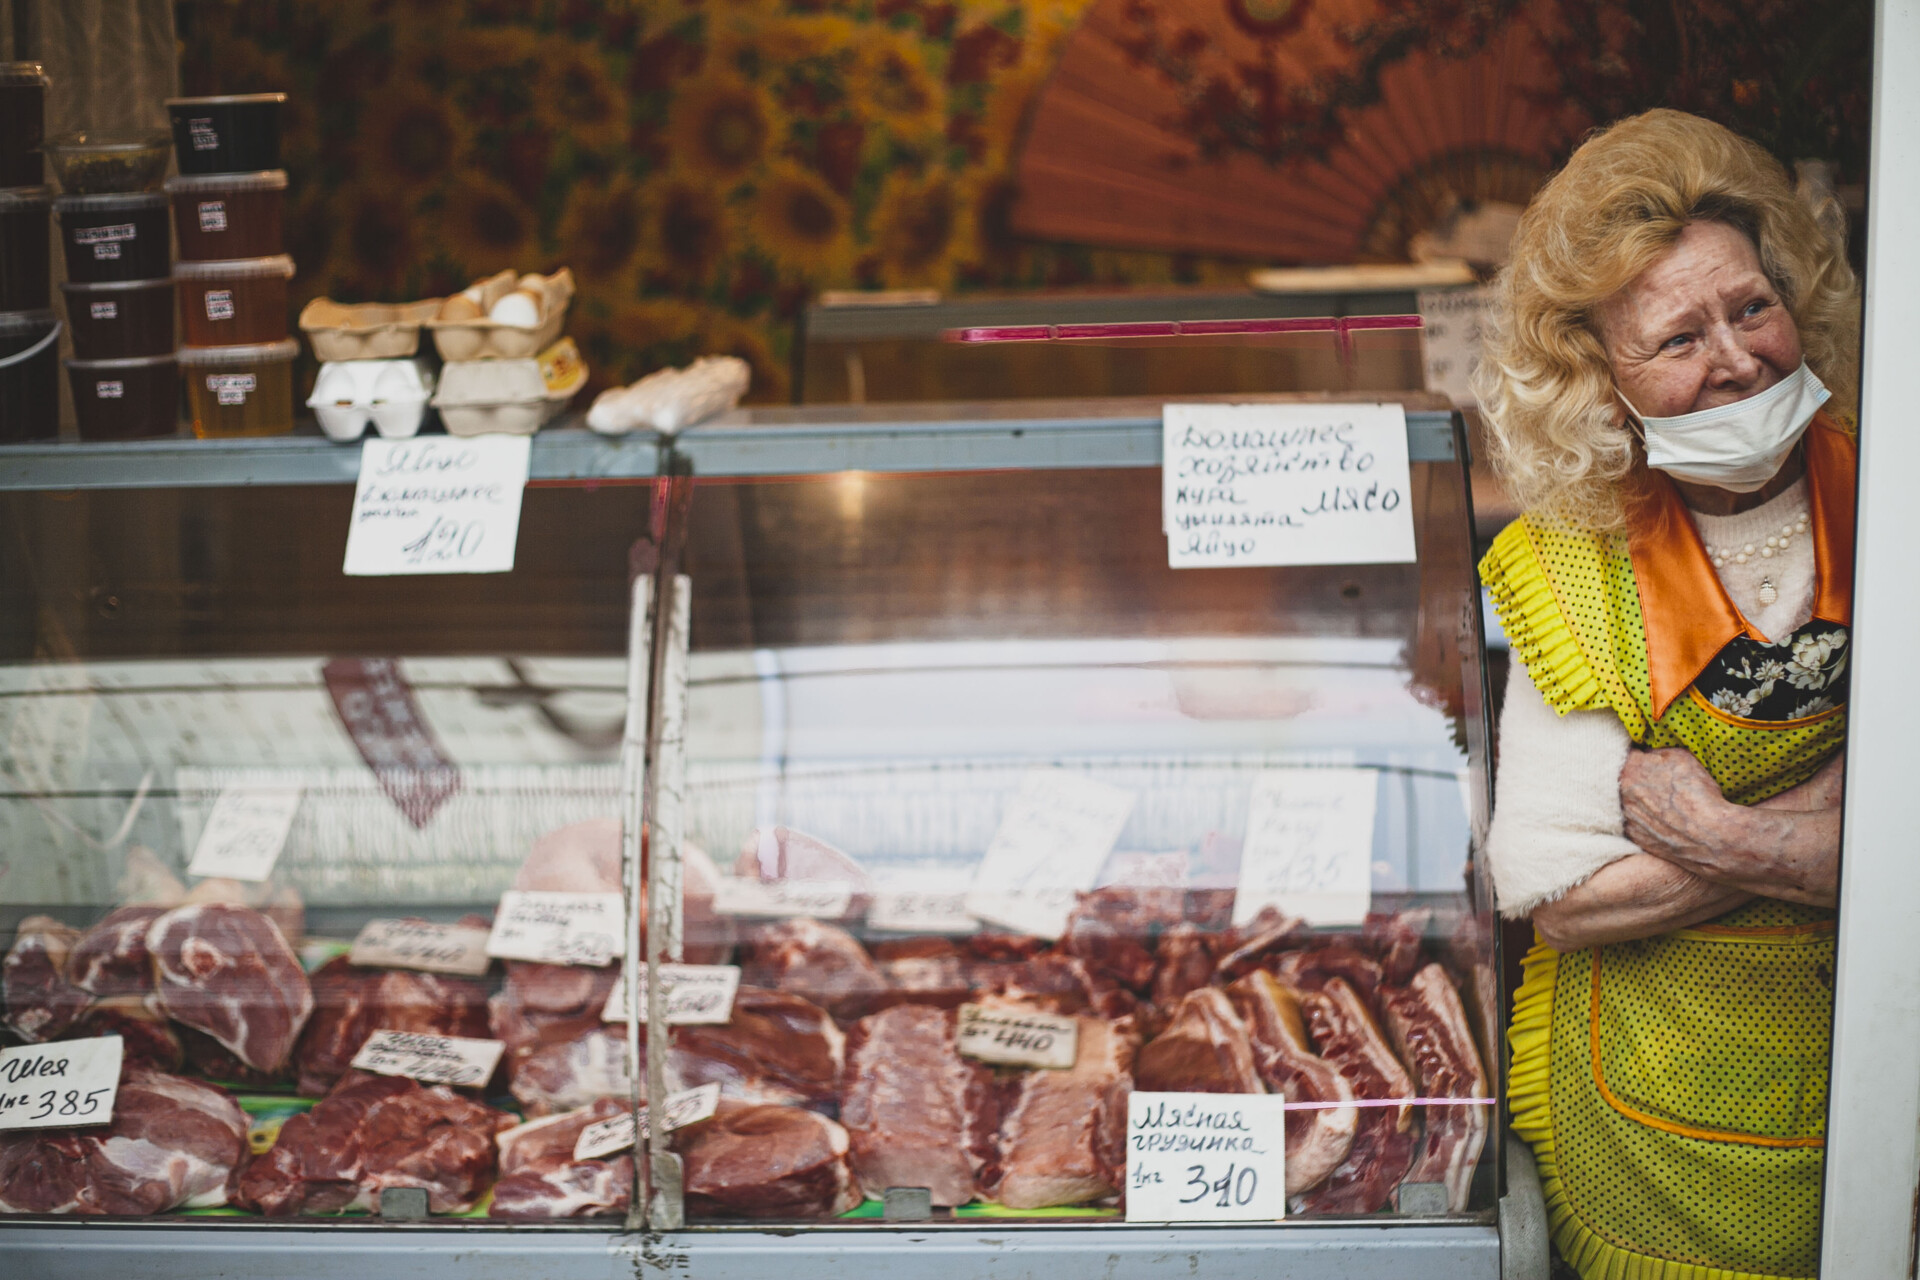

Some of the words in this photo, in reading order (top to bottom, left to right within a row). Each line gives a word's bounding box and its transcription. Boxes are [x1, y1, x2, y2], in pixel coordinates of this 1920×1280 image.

[1, 1056, 69, 1083] Шея
[29, 1088, 110, 1119] 385
[1133, 1102, 1250, 1131] Мясная
[1132, 1132, 1266, 1154] грудинка
